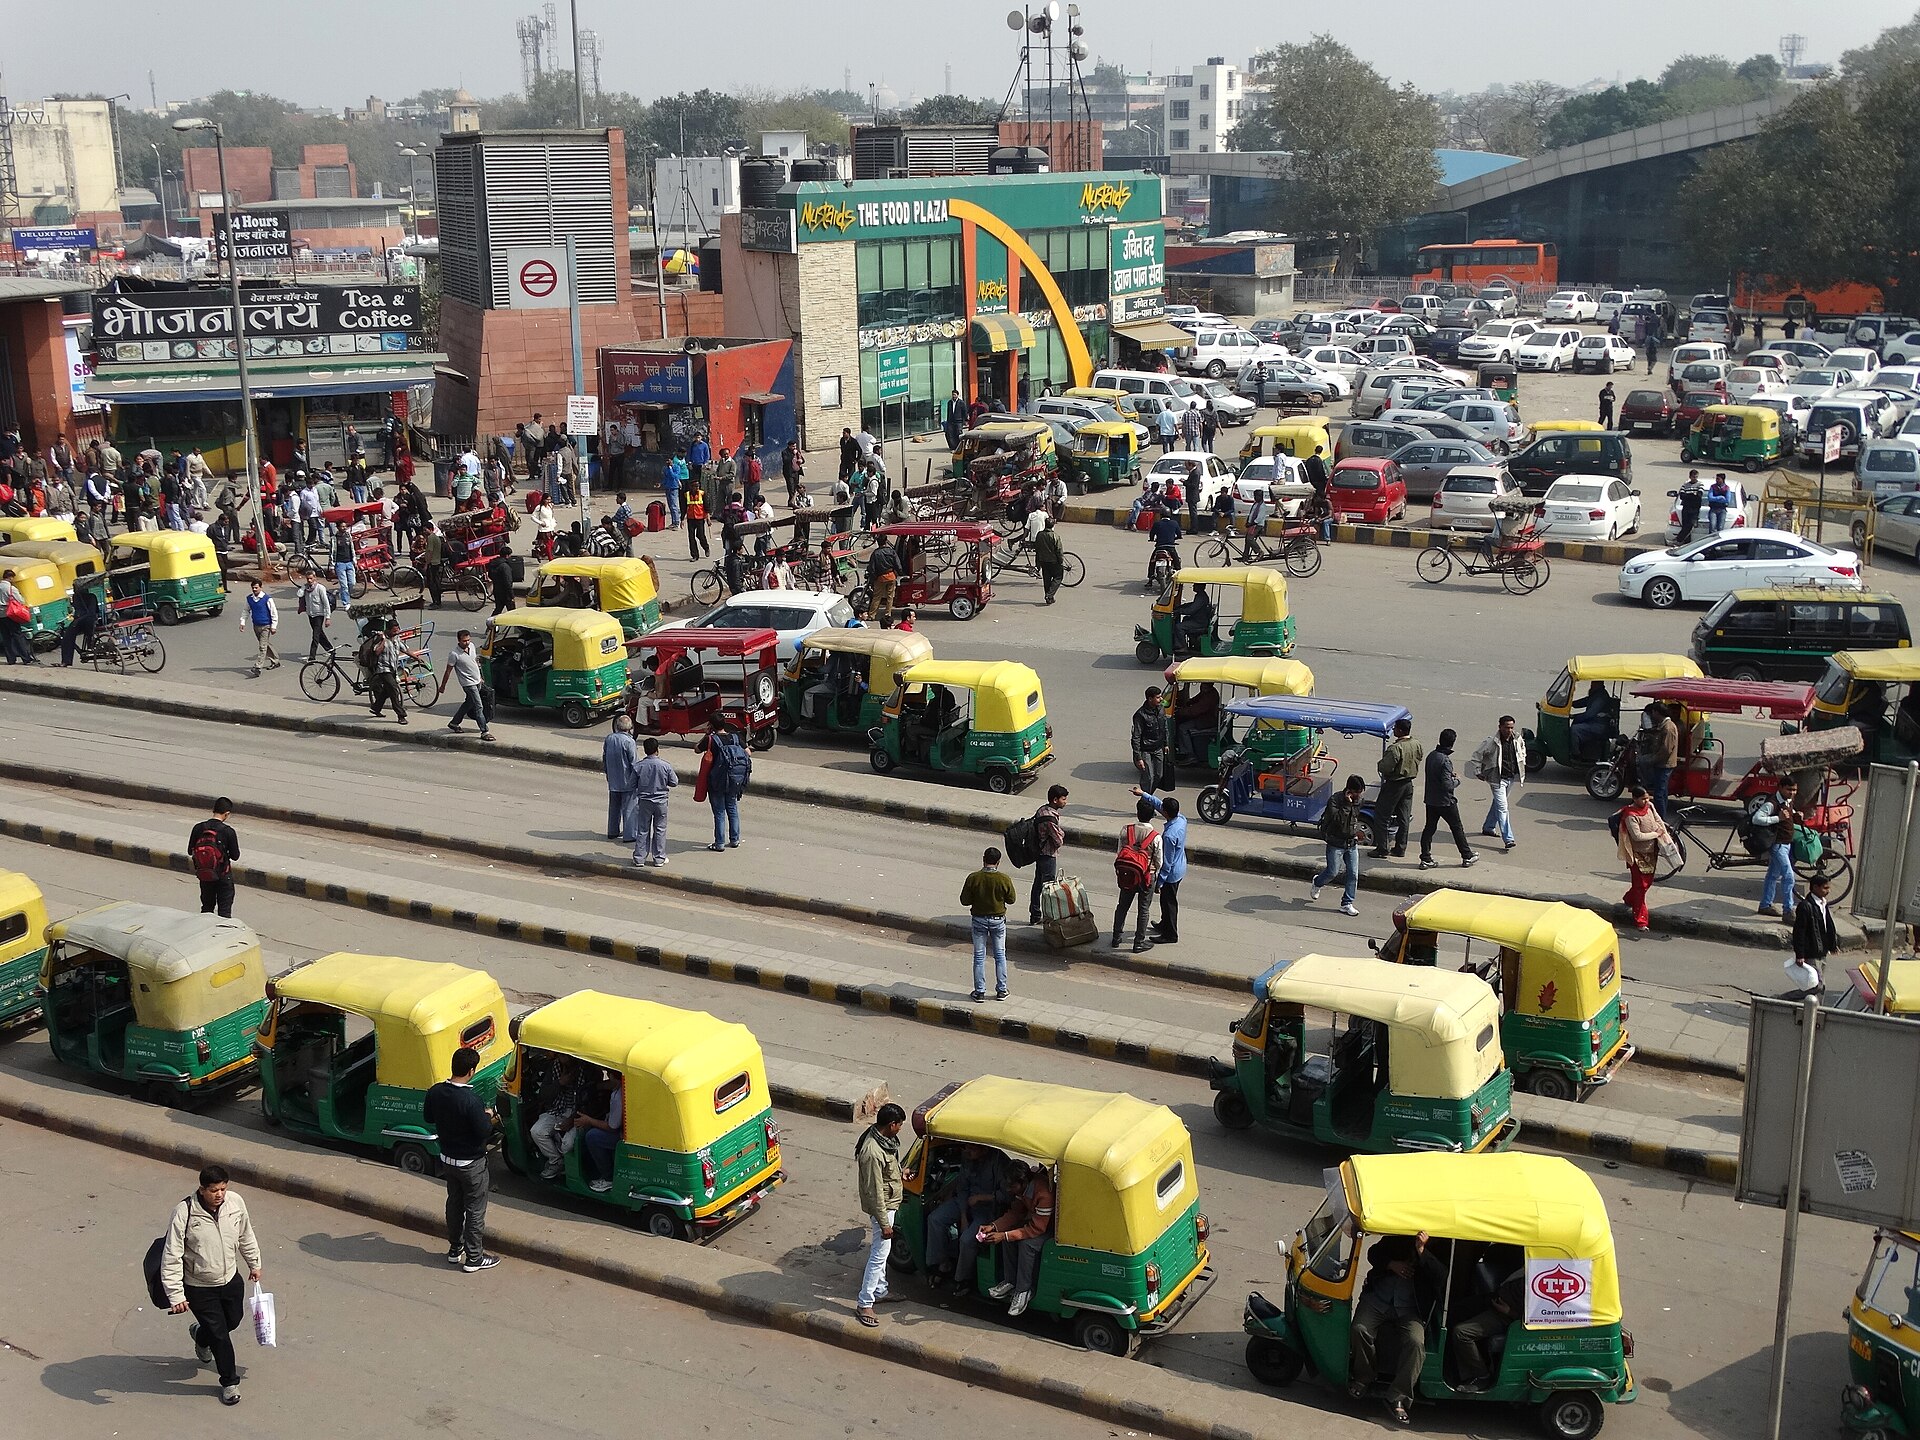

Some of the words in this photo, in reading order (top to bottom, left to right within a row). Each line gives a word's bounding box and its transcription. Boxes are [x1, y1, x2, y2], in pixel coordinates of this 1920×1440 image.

[1141, 160, 1168, 171] EXIT
[242, 215, 279, 228] Hours
[858, 203, 879, 226] THE
[882, 201, 910, 225] FOOD
[914, 200, 948, 223] PLAZA
[1122, 230, 1143, 260] उचित
[1143, 236, 1155, 257] दर
[1114, 269, 1132, 292] खान
[1133, 266, 1147, 288] पान
[1149, 257, 1164, 286] सेवा
[250, 293, 265, 302] वेज
[342, 289, 386, 307] Tea
[392, 294, 405, 306] &
[1133, 297, 1148, 309] उचित
[103, 297, 321, 335] भोजनालय
[339, 309, 413, 328] Coffee
[343, 366, 408, 376] PEPSI
[644, 361, 660, 376] रेलवे
[665, 362, 685, 380] पुलिस
[628, 381, 645, 392] दिल्ली
[650, 382, 662, 393] रेलवे
[666, 383, 682, 394] स्टेशन
[1543, 1278, 1575, 1294] T.T.
